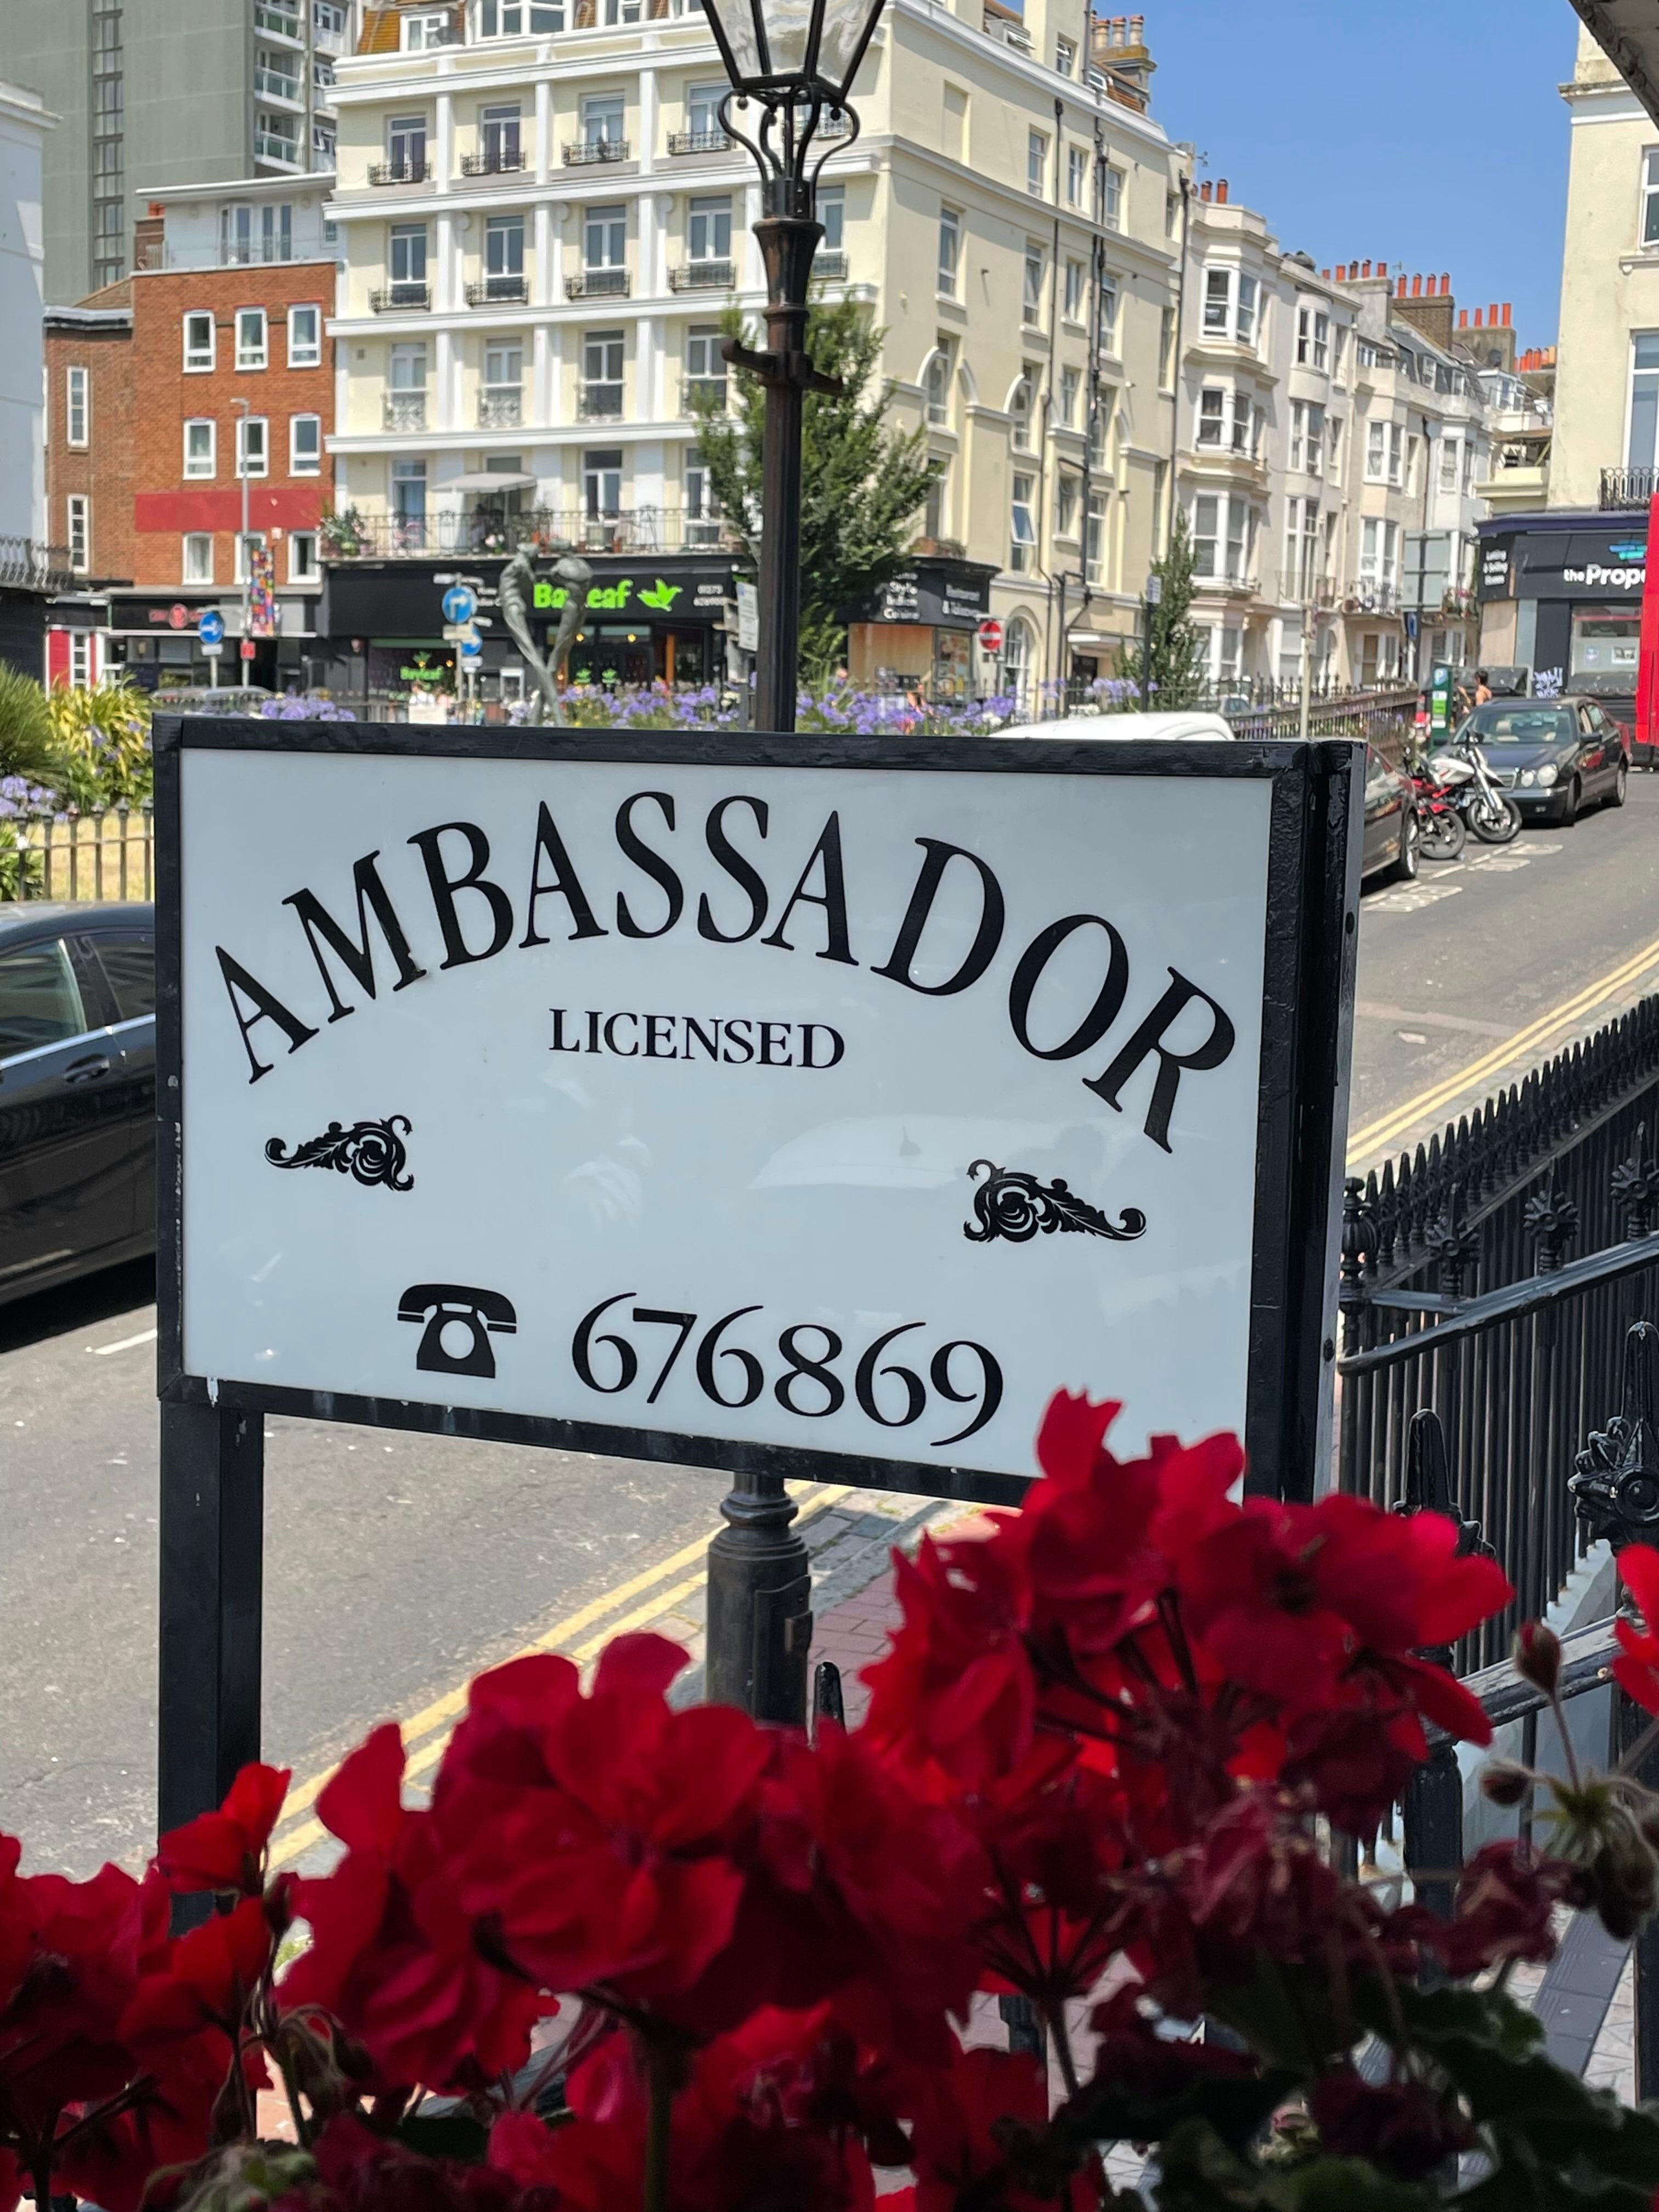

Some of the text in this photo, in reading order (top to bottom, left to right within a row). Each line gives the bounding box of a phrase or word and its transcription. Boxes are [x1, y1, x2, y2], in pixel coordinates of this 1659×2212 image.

[533, 579, 634, 608] Baeaf
[1564, 569, 1585, 583] the
[215, 791, 1235, 1154] AMBASSADOR
[549, 1008, 845, 1069] LICENSED
[572, 1293, 1003, 1446] 676869
